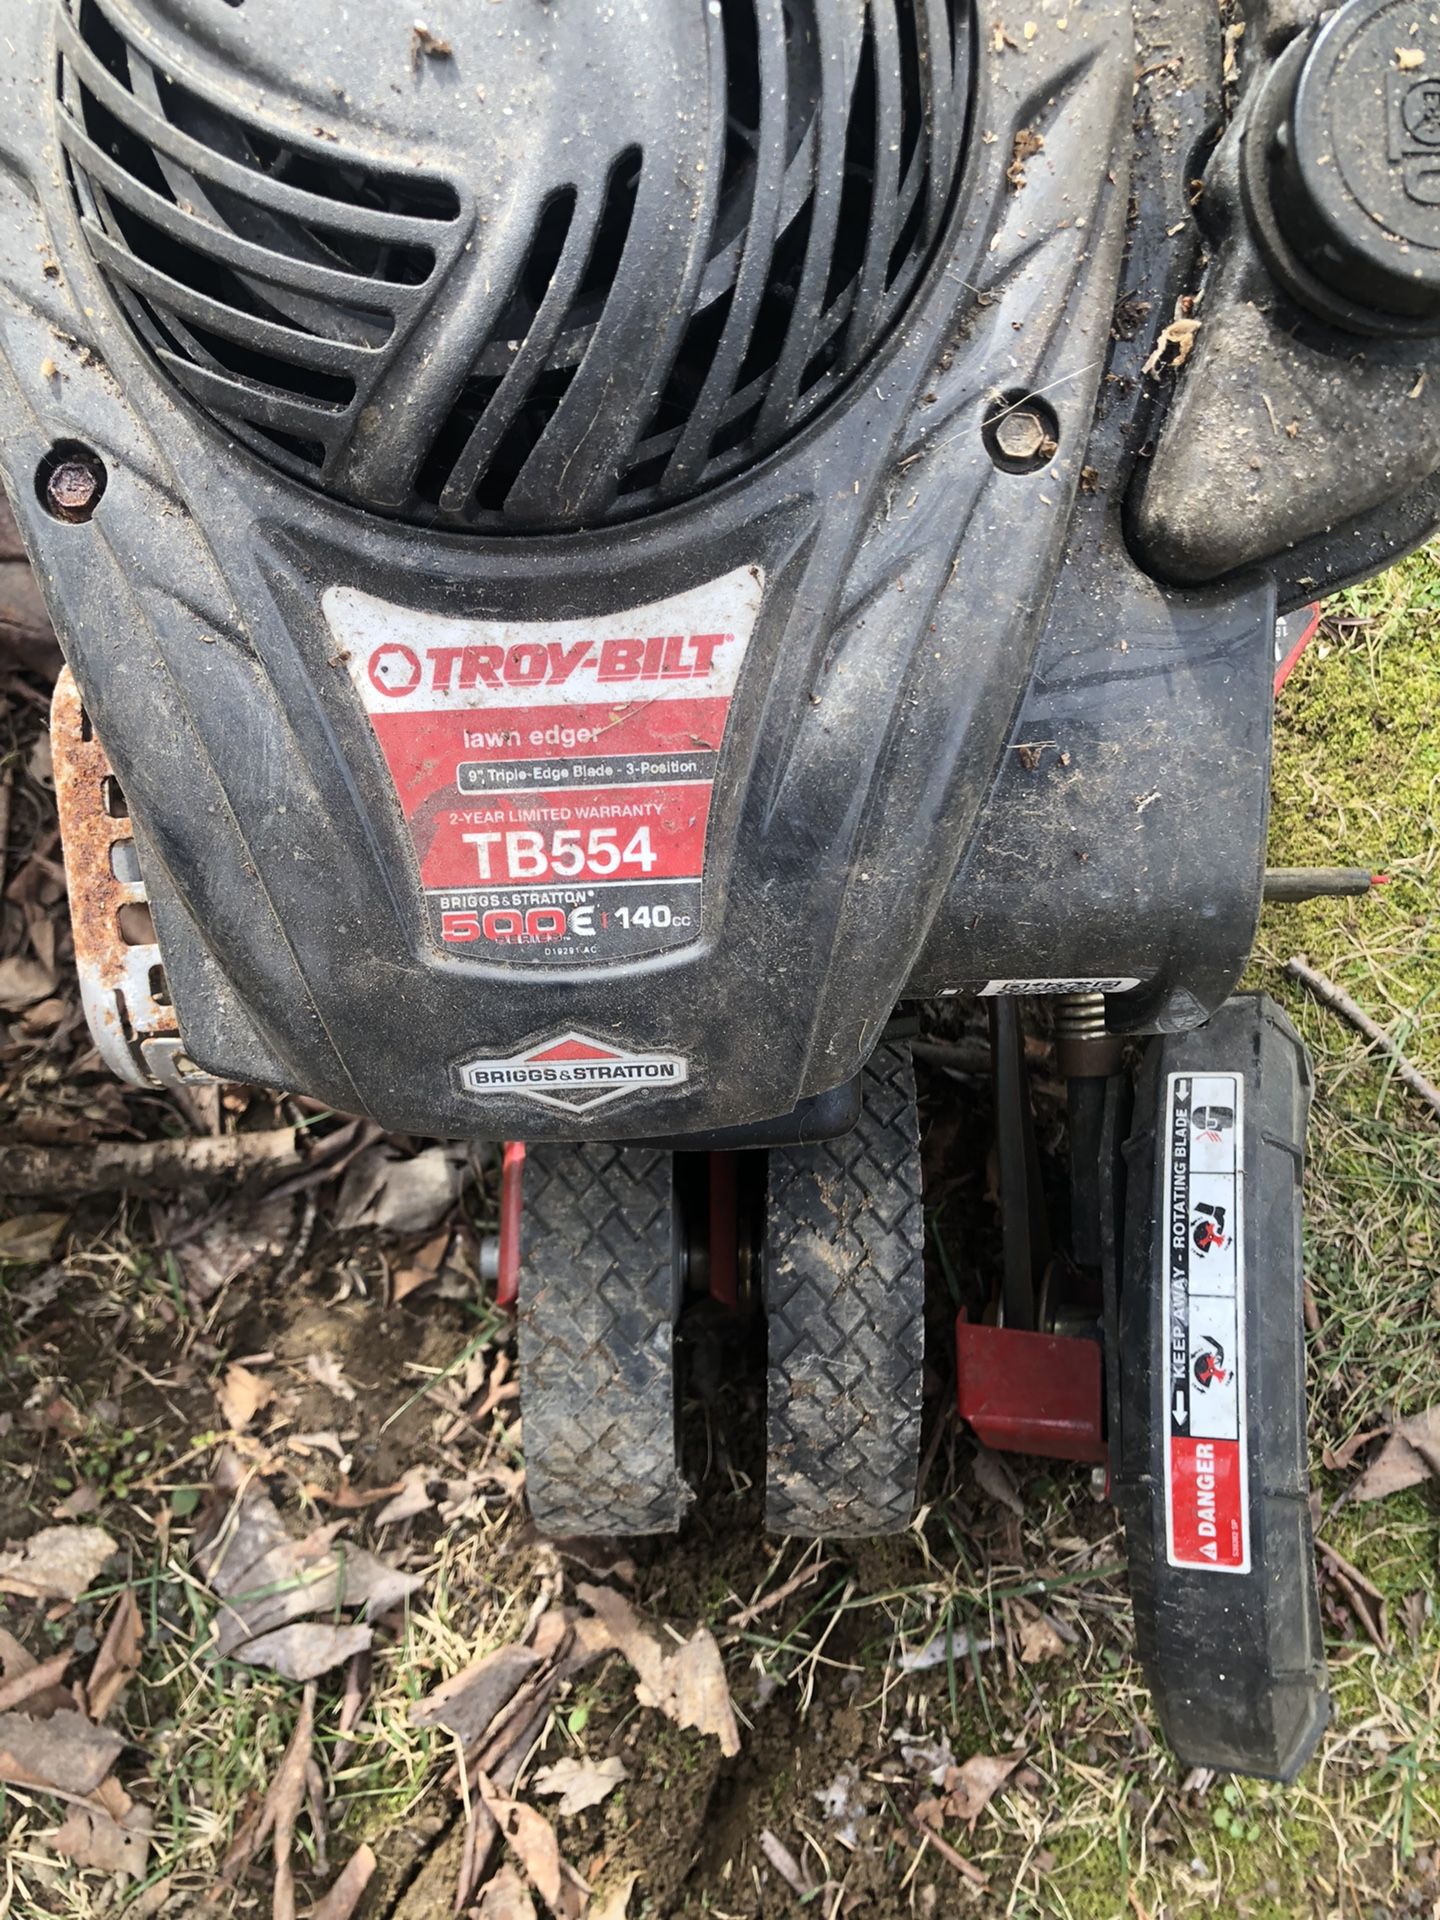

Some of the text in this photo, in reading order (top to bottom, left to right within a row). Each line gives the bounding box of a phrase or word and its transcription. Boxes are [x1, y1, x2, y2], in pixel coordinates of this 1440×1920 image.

[463, 725, 600, 748] lawn edger
[487, 767, 569, 784] Triple-Edge
[573, 764, 614, 778] Blade
[626, 761, 697, 776] 3-Position
[450, 804, 664, 825] 2-YEAR LIMITED WARRANTY
[462, 826, 657, 879] TB554
[1175, 1109, 1187, 1156] BLADE
[1173, 1162, 1187, 1248] ROTATING
[1174, 1268, 1188, 1321] AWAY
[1173, 1327, 1187, 1378] KEEP
[1197, 1443, 1217, 1537] DANGER
